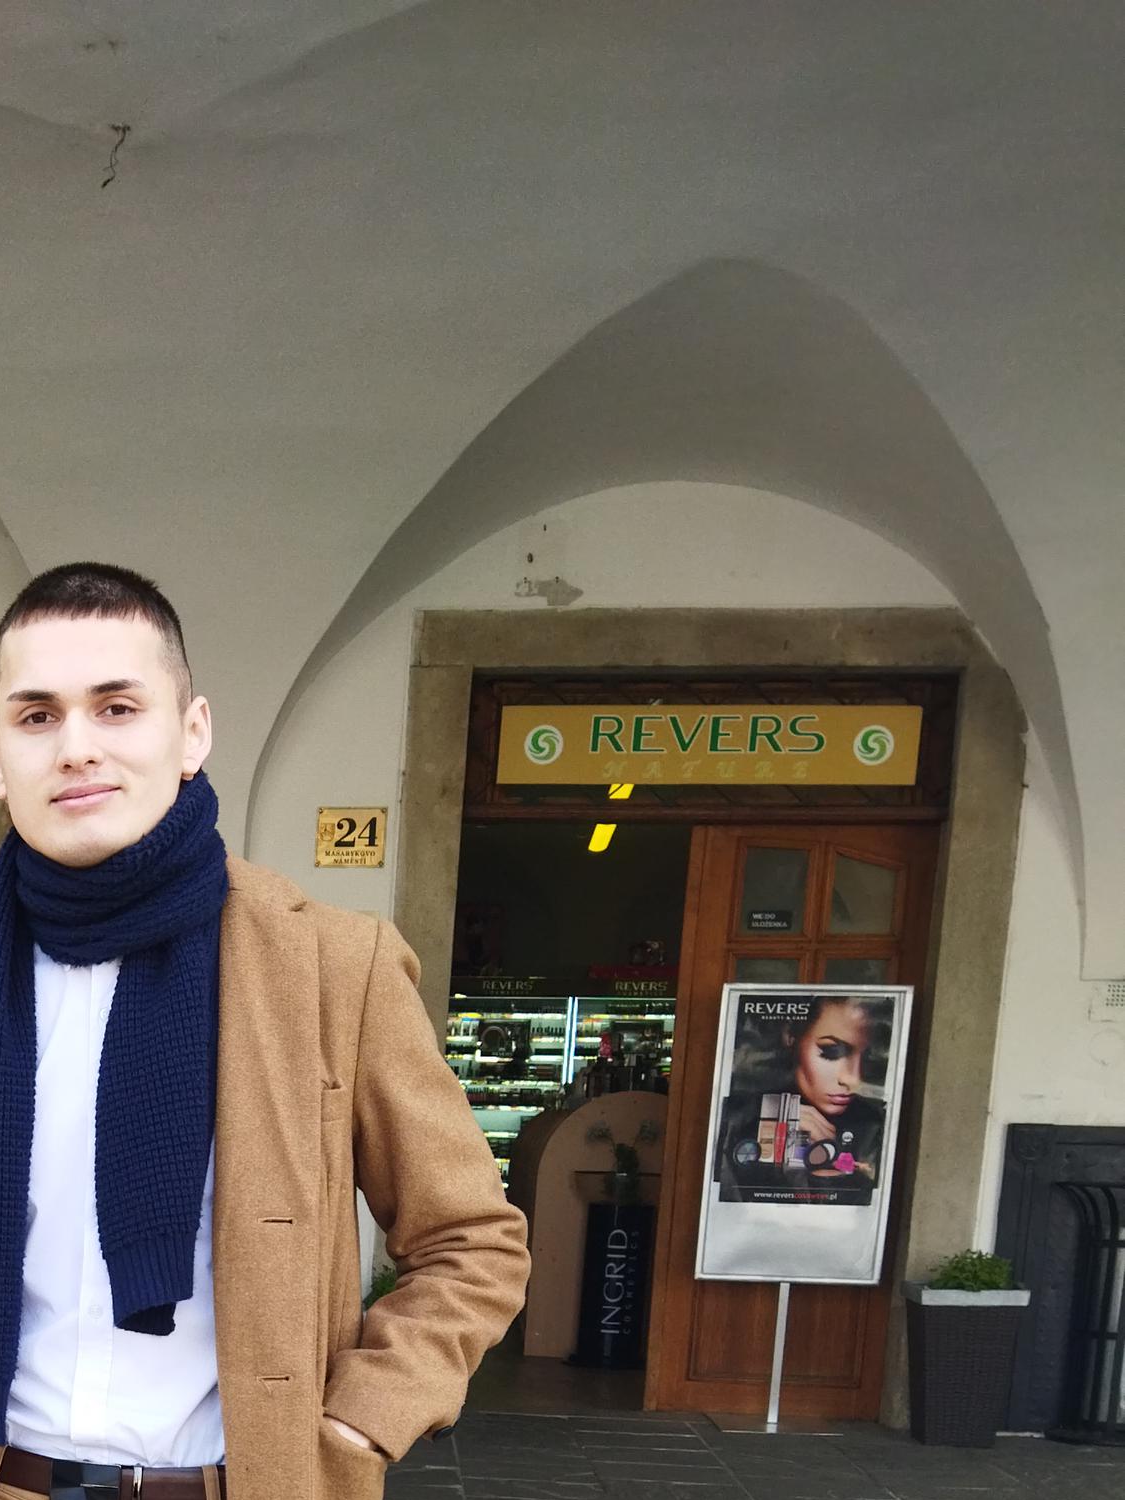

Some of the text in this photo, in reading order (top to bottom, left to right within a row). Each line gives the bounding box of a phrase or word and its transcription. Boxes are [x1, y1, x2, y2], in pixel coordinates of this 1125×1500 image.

[588, 714, 826, 754] REVERS
[334, 816, 379, 848] 24
[482, 981, 534, 990] REVERS
[615, 981, 667, 990] REVERS
[744, 1002, 810, 1015] REVERS
[600, 1229, 628, 1334] INGRID
